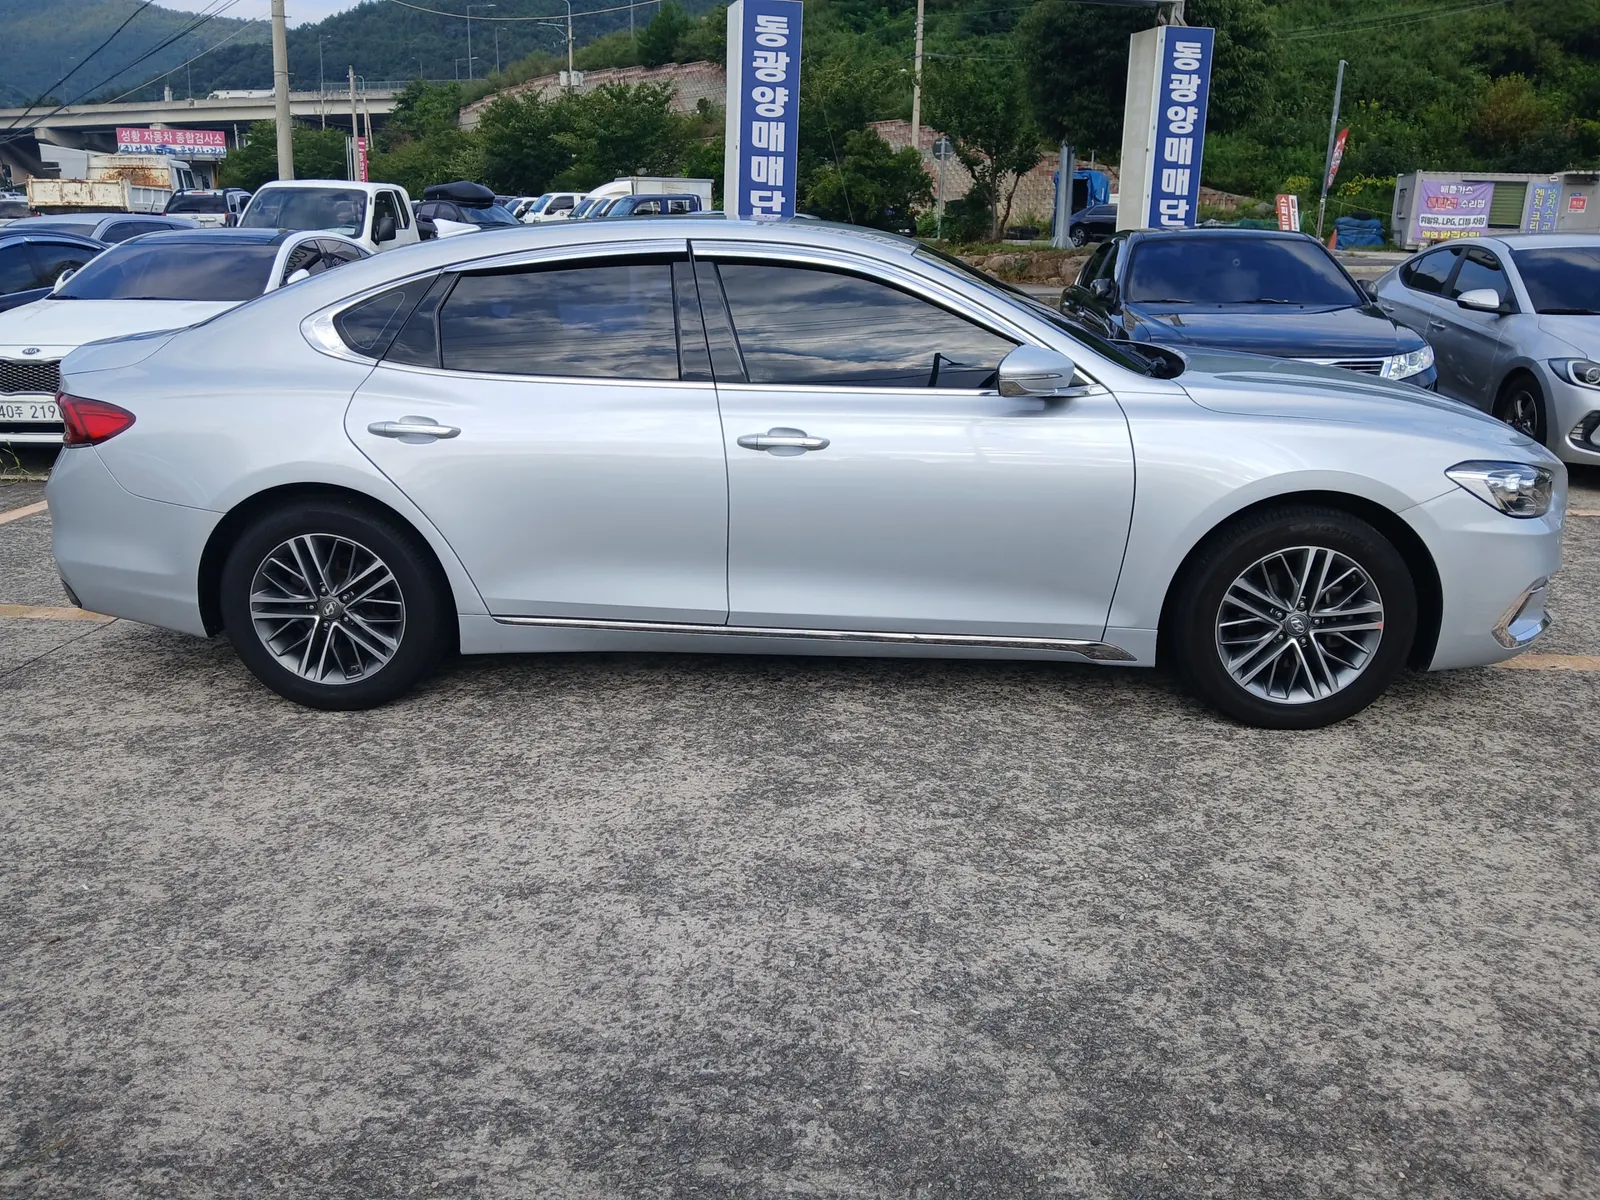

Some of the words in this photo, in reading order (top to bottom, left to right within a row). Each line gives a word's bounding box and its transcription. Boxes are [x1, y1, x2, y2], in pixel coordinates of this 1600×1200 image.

[121, 130, 140, 142] 성황
[144, 131, 172, 143] 자동차
[175, 132, 223, 144] 종합검사소
[1533, 188, 1545, 209] 엔진
[1543, 188, 1558, 219] 냉각수
[1529, 211, 1541, 233] 크리
